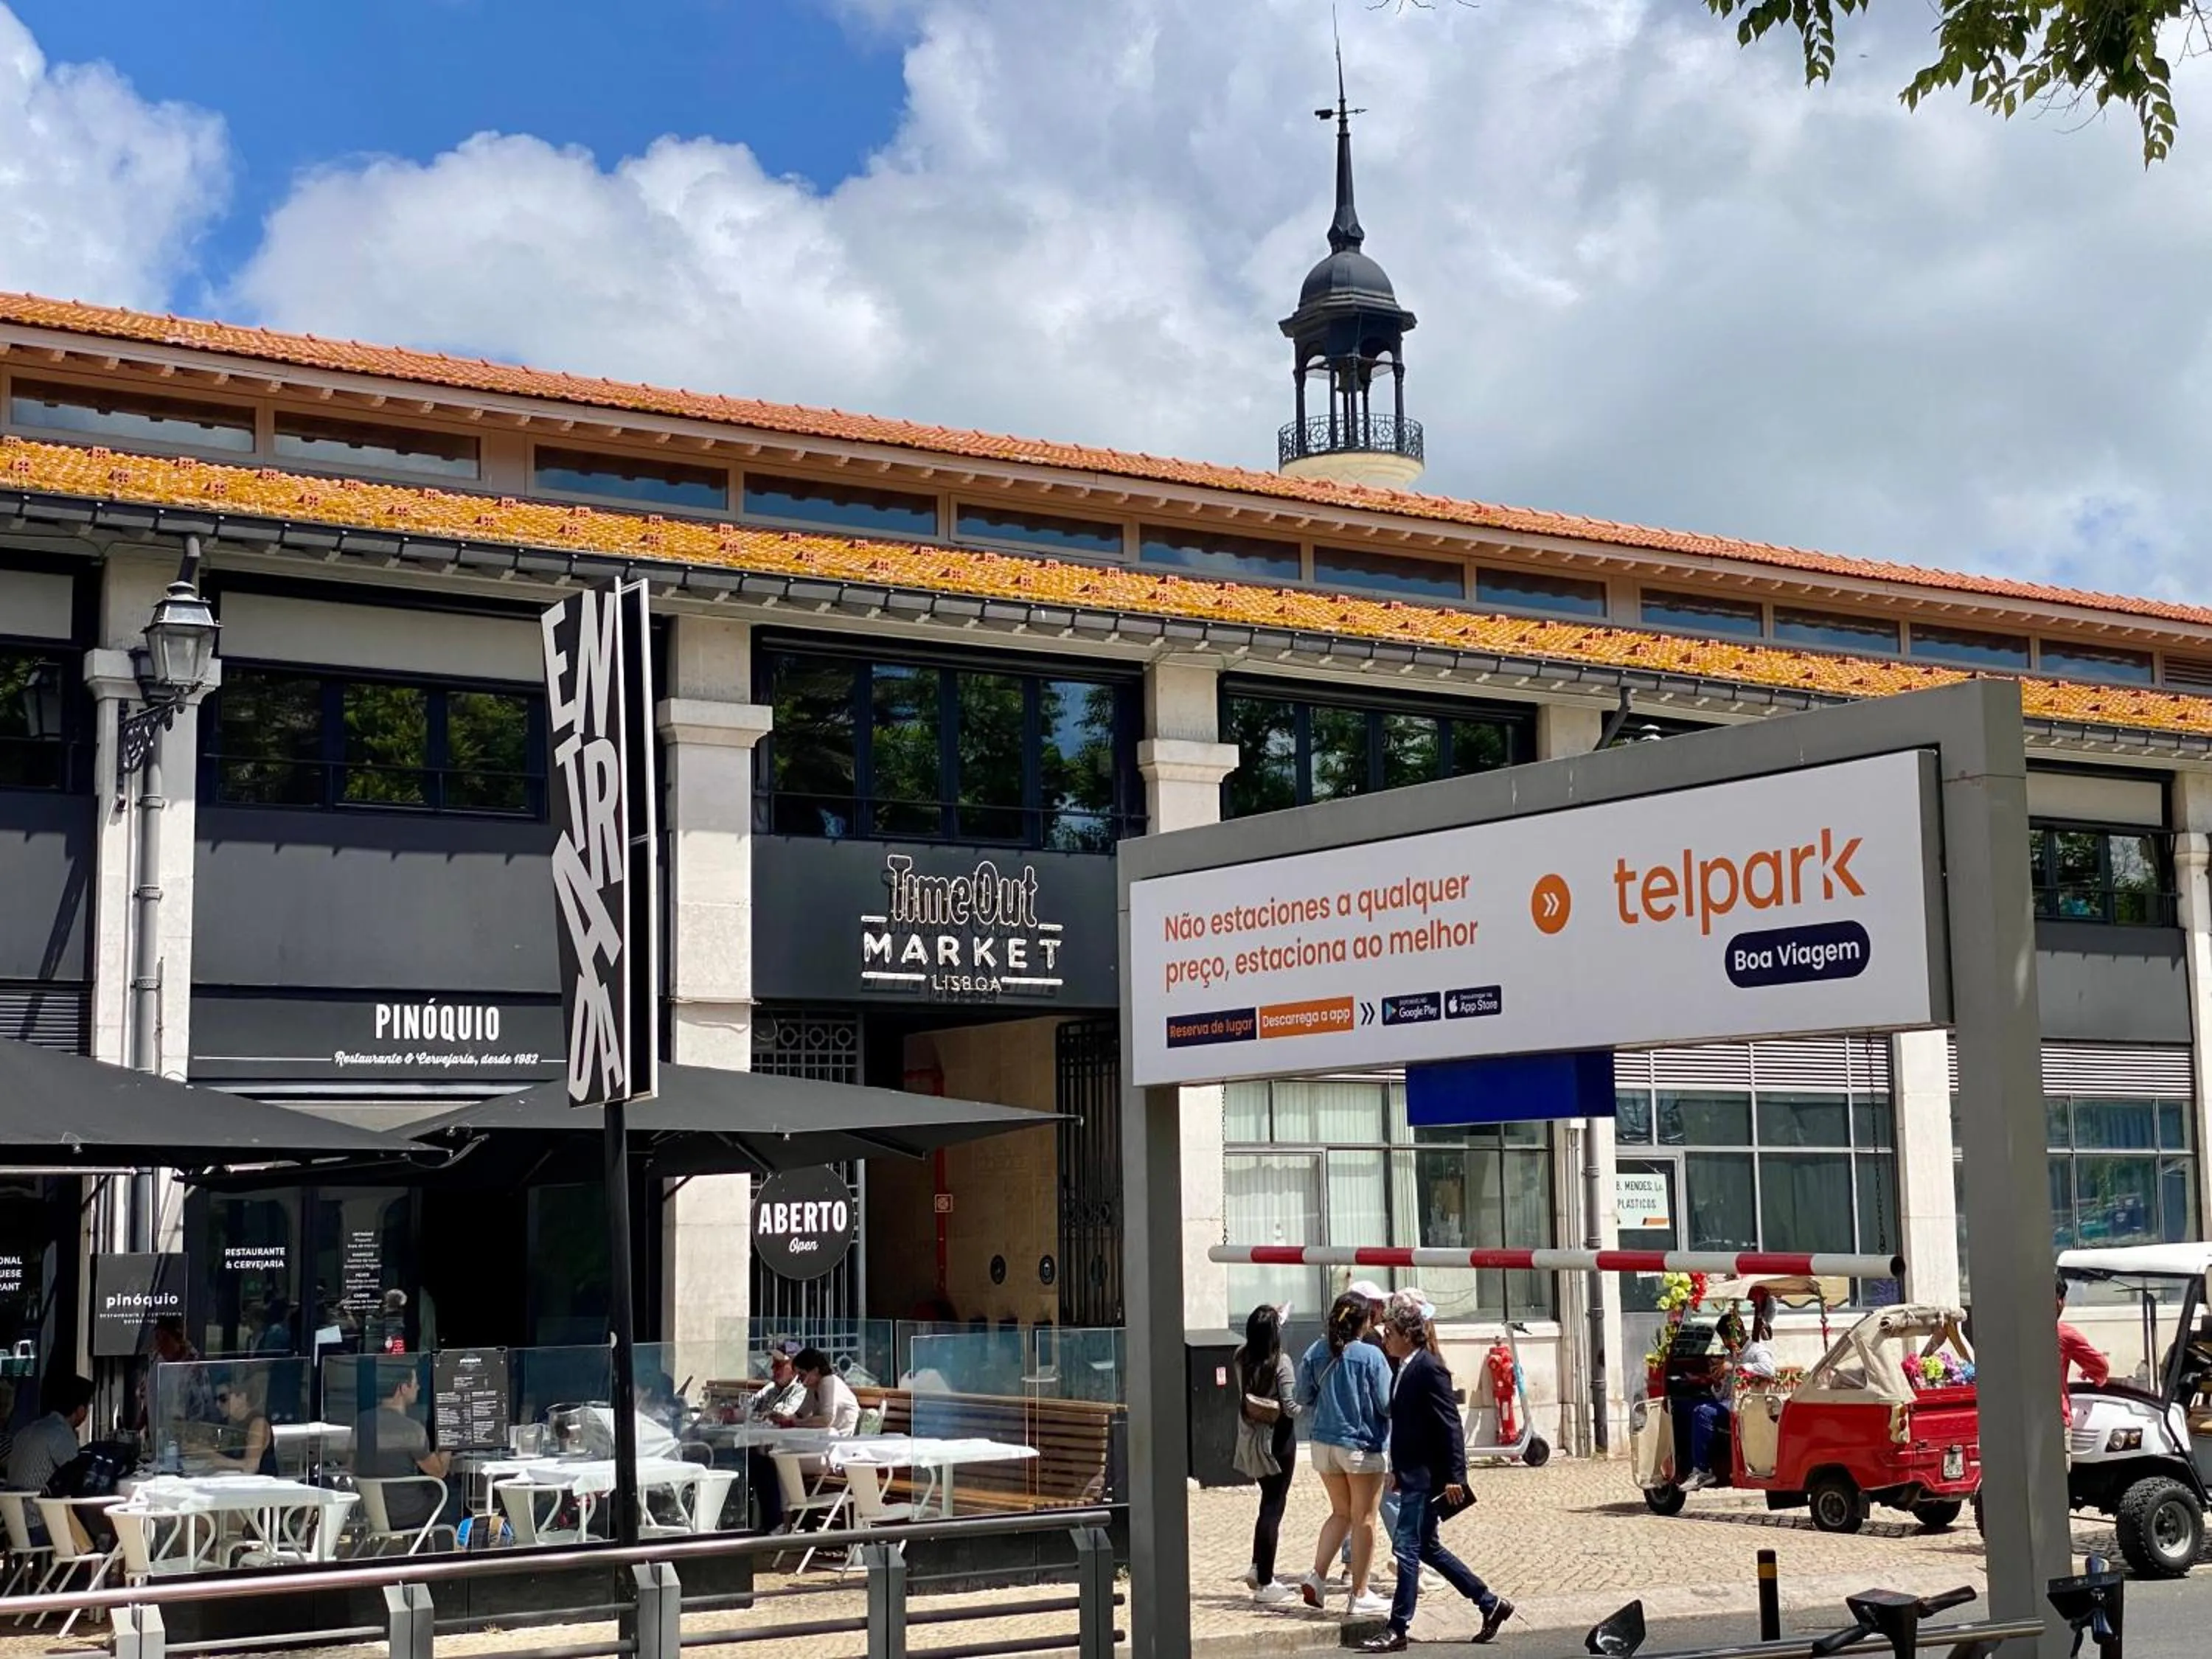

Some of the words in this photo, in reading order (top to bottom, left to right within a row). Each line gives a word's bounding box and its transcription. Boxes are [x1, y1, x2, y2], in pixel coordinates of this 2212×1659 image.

[1613, 828, 1866, 936] telpark
[1164, 912, 1206, 942] Não
[1211, 897, 1330, 935] estaciones
[1337, 893, 1352, 917] a
[1357, 874, 1470, 922] qualquer
[863, 931, 1062, 970] MARKET
[1166, 955, 1229, 992] preço,
[1235, 937, 1346, 975] estaciona
[1353, 933, 1382, 960] ao
[1390, 918, 1478, 955] melhor
[1734, 950, 1772, 972] Boa
[1777, 940, 1860, 970] Viagem
[931, 974, 1002, 992] LISBOA
[1399, 1005, 1423, 1019] Google
[1424, 1004, 1438, 1017] Play
[1460, 1001, 1476, 1014] App
[1477, 999, 1498, 1011] Store
[375, 998, 500, 1042] PINÓQUIO
[1262, 1010, 1318, 1028] Descarrega
[1321, 1011, 1328, 1022] a
[1329, 1007, 1351, 1024] app
[1169, 1024, 1209, 1039] Reserva
[1211, 1019, 1224, 1034] de
[1225, 1018, 1253, 1037] lugar
[334, 1050, 403, 1068] Restaurante
[404, 1051, 414, 1065] &
[480, 1053, 512, 1065] desde
[513, 1053, 539, 1065] 1982
[758, 1200, 848, 1235] ABERTO
[225, 1247, 285, 1256] RESTAURANTE
[788, 1237, 819, 1253] Open
[233, 1259, 285, 1270] CERVEJARIA
[105, 1293, 178, 1310] pinóquio
